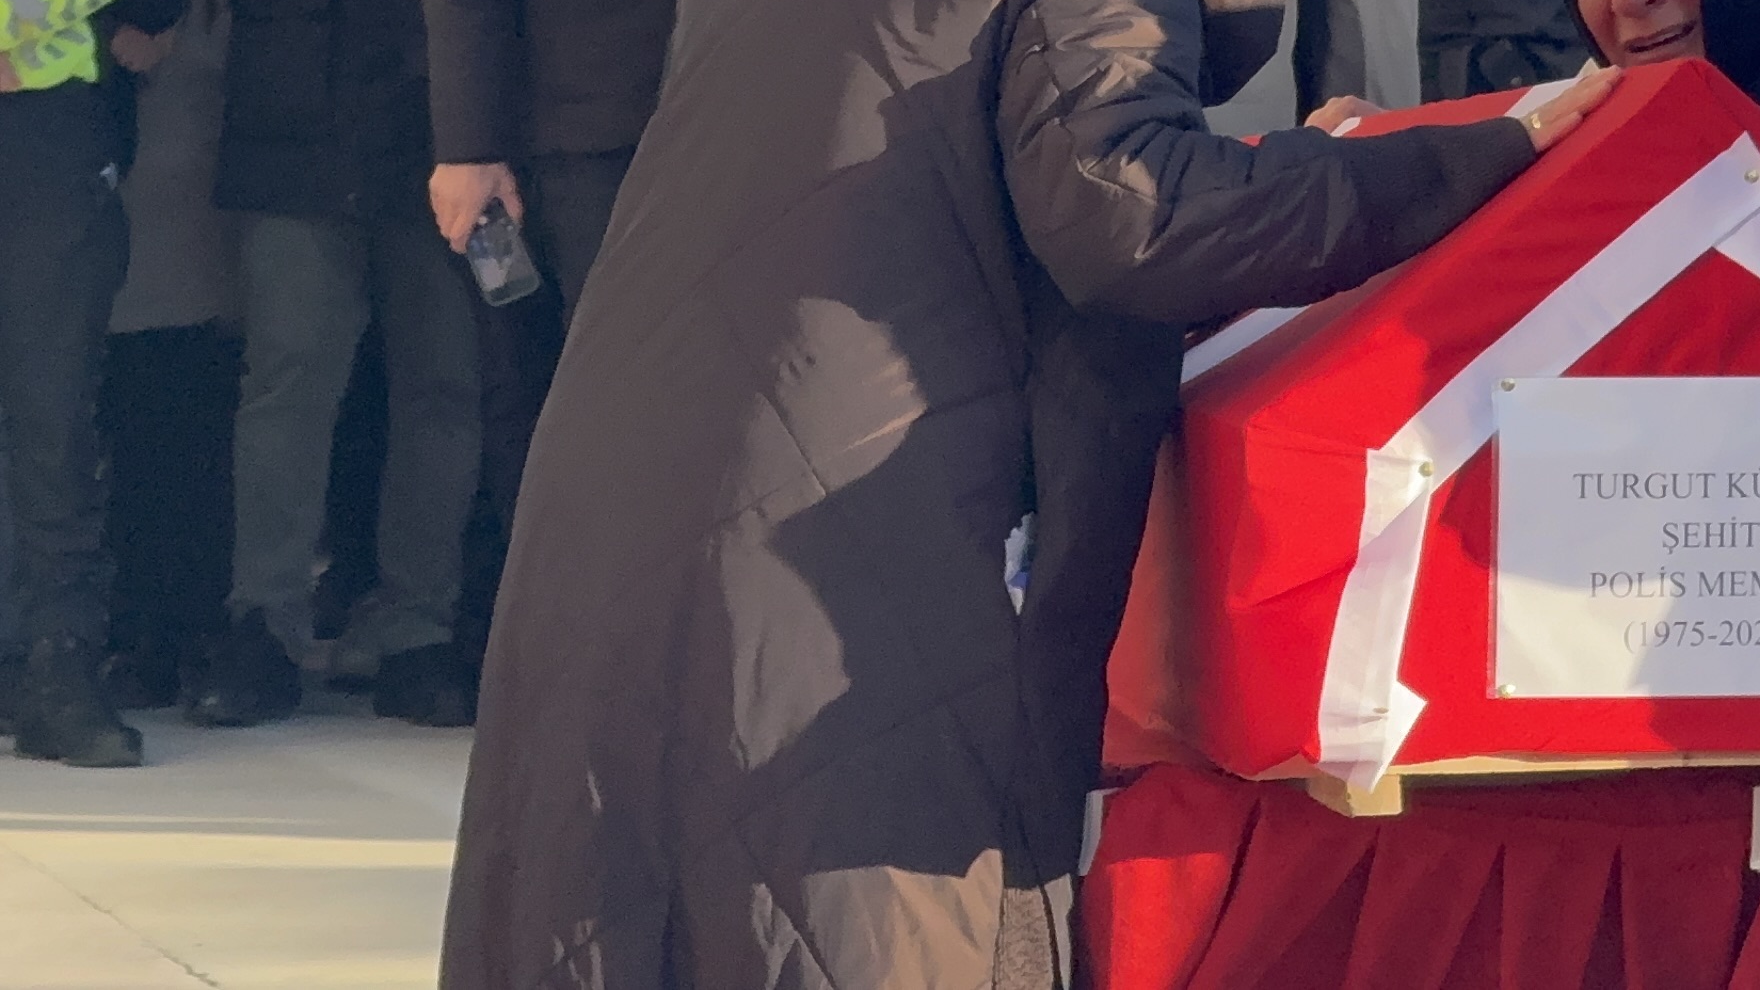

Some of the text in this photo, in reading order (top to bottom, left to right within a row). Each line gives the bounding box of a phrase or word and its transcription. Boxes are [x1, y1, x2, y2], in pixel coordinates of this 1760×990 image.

[1573, 472, 1716, 500] TURGUT
[1661, 516, 1760, 555] ŞEHİT
[1589, 566, 1687, 599] POLİS
